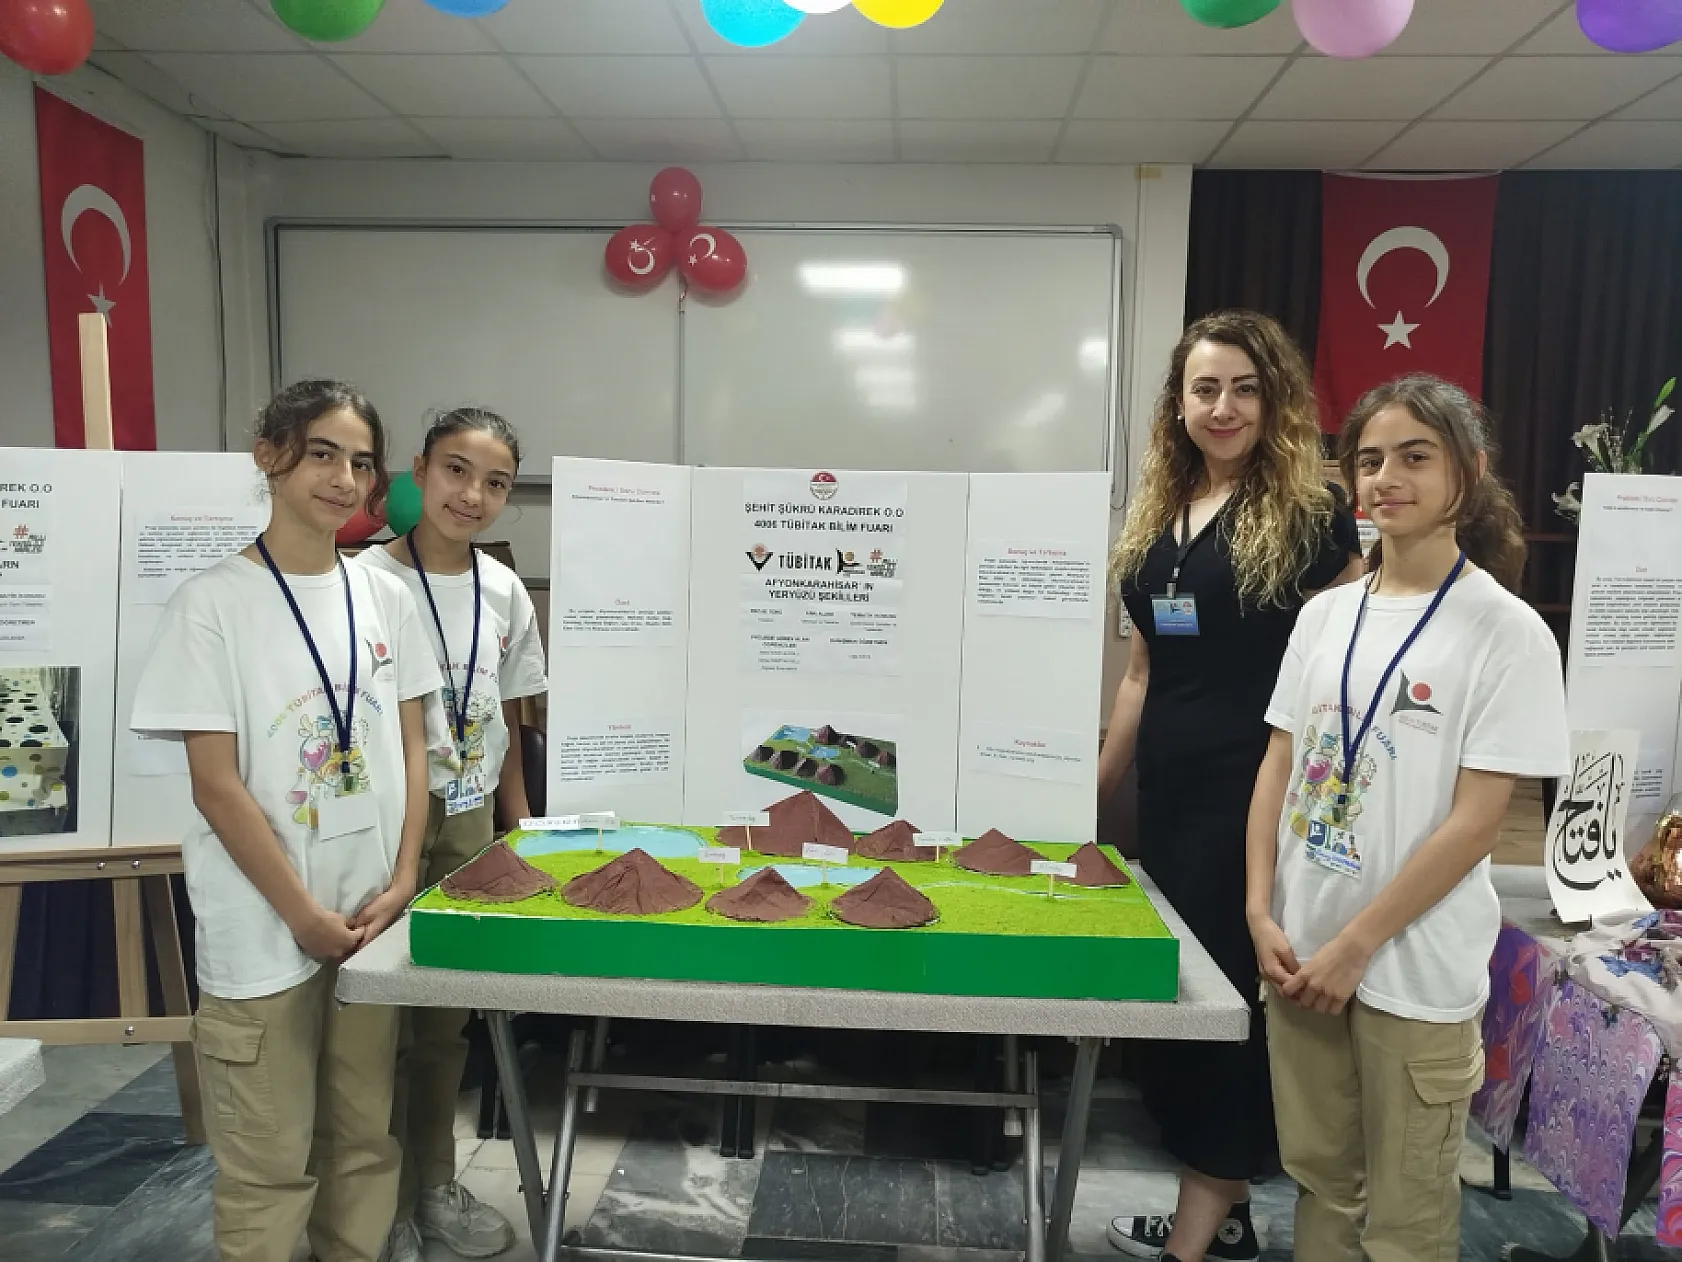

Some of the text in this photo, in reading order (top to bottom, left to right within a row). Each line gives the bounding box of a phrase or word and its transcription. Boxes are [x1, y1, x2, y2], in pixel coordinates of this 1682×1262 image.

[1, 499, 40, 508] FUARI
[744, 503, 776, 513] ŞEHİT
[778, 502, 816, 515] ŞÜKRÜ
[780, 518, 827, 531] TÜBİTAK
[829, 520, 858, 532] BİLİM
[860, 523, 893, 533] FUARI
[778, 552, 833, 571] TÜBİTAK
[769, 588, 870, 603] YERYÜZÜ ŞEKİLLERİ
